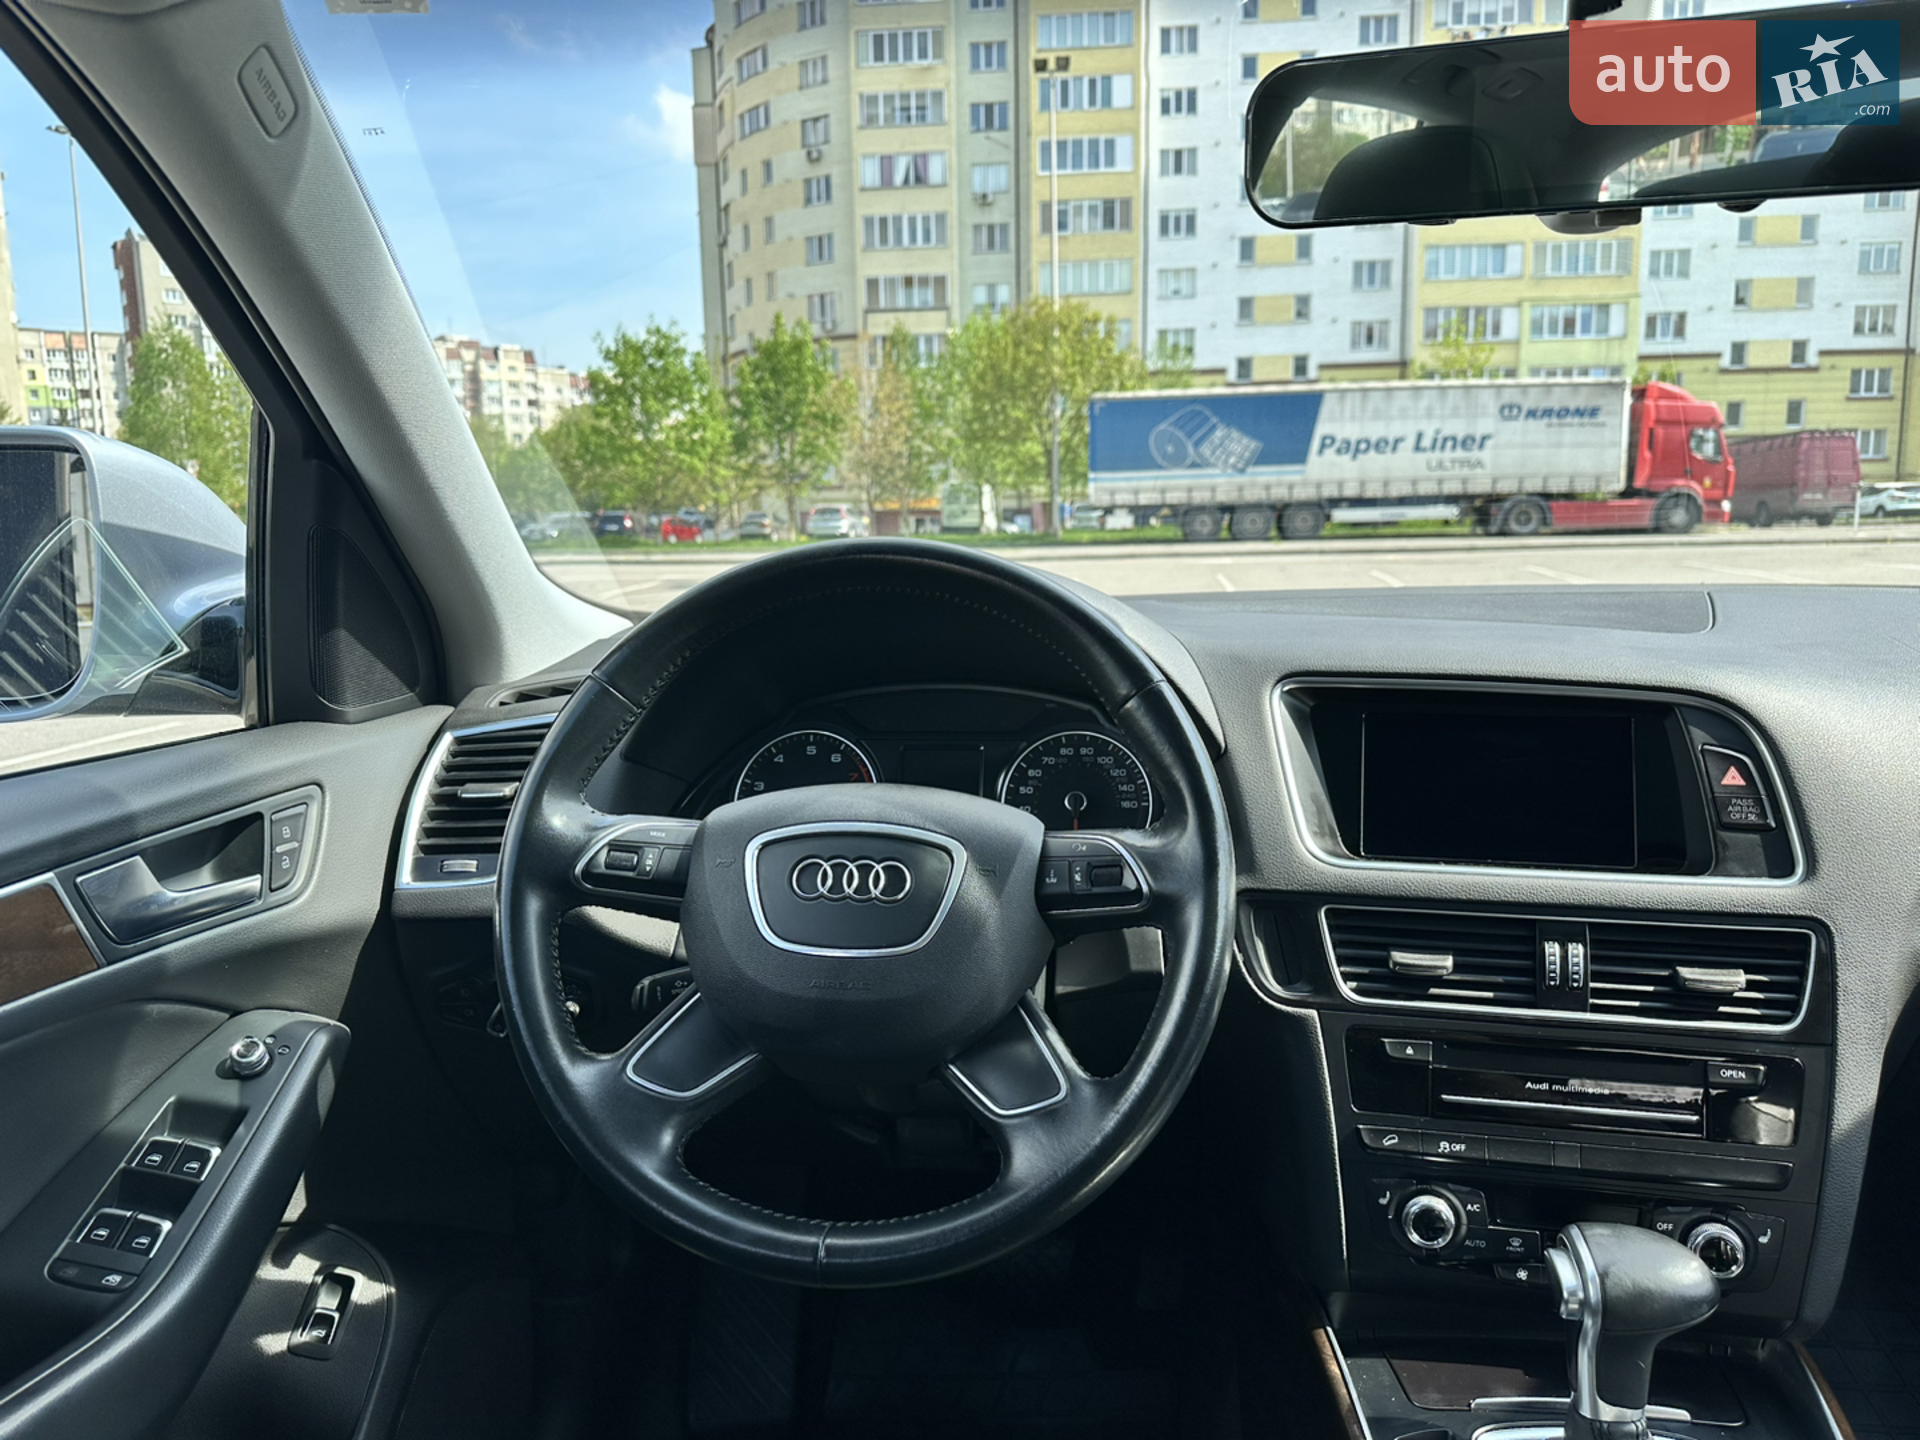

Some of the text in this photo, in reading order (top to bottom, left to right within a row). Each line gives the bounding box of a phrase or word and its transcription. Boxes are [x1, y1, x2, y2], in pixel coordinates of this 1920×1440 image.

[255, 67, 287, 123] AIRBAG
[1524, 405, 1603, 420] KRONE
[1317, 428, 1495, 461] Paper Liner
[1426, 458, 1485, 472] ULTRA
[806, 746, 817, 755] 5
[1059, 747, 1074, 755] 80
[1079, 747, 1094, 755] 90
[773, 754, 784, 763] 4
[830, 753, 842, 763] 6
[1041, 757, 1056, 765] 70
[1096, 756, 1114, 764] 100
[1027, 769, 1042, 777] 60
[1109, 769, 1127, 777] 120
[753, 782, 765, 791] 3
[1019, 786, 1034, 794] 50
[1118, 784, 1135, 792] 140
[1120, 800, 1138, 809] 160
[809, 979, 873, 992] AIRBAG
[1720, 1068, 1746, 1079] OPEN
[1525, 1081, 1610, 1095] Audi multimedia
[1451, 1143, 1467, 1152] OFF
[1466, 1203, 1481, 1212] A/C
[1656, 1222, 1674, 1231] OFF
[1464, 1239, 1487, 1248] AUTO
